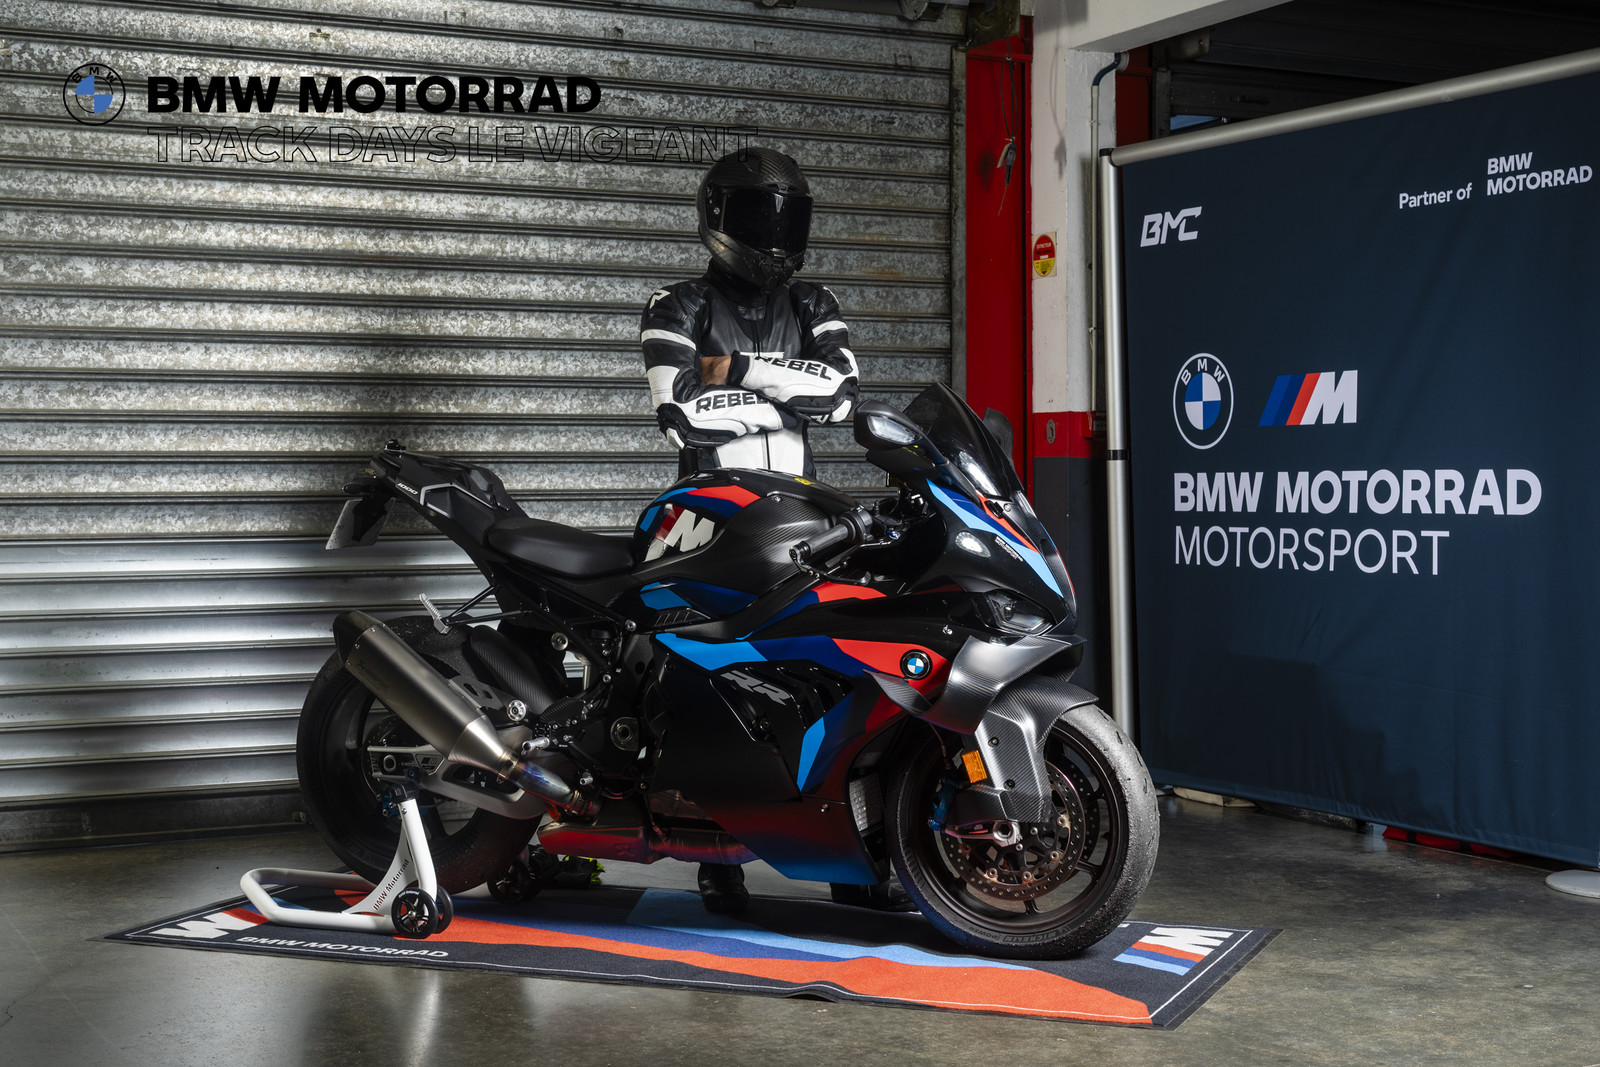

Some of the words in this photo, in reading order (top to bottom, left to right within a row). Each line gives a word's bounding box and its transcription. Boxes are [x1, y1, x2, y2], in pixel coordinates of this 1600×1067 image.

[1486, 151, 1534, 175] BMW
[1486, 165, 1593, 196] MOTORRAD
[1399, 188, 1453, 209] Partner
[1456, 182, 1473, 201] of
[1140, 206, 1202, 247] BMC
[1181, 358, 1226, 386] BMW
[397, 482, 418, 495] 1000
[1174, 472, 1264, 513] BMW
[1276, 469, 1543, 516] MOTORRAD
[1175, 525, 1451, 576] MOTORSPORT
[373, 890, 388, 911] BMW
[386, 858, 410, 892] Motorrad
[236, 936, 306, 946] BMW
[302, 942, 450, 957] MOTORRAD
